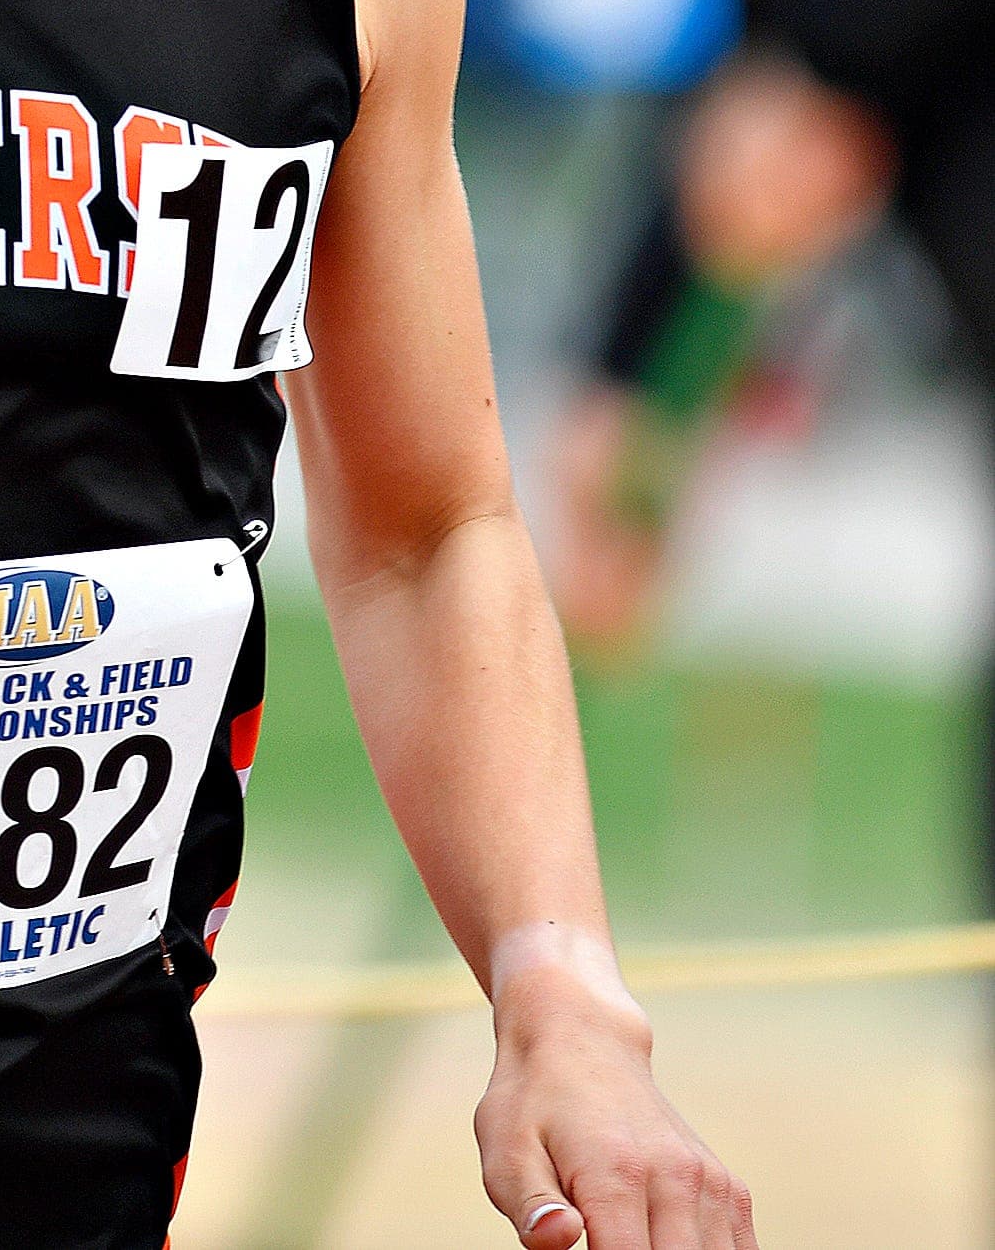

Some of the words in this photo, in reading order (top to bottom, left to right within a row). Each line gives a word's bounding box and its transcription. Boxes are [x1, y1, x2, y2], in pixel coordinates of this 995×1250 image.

[159, 159, 310, 369] 12
[66, 673, 89, 698] &
[101, 656, 193, 695] FIELD
